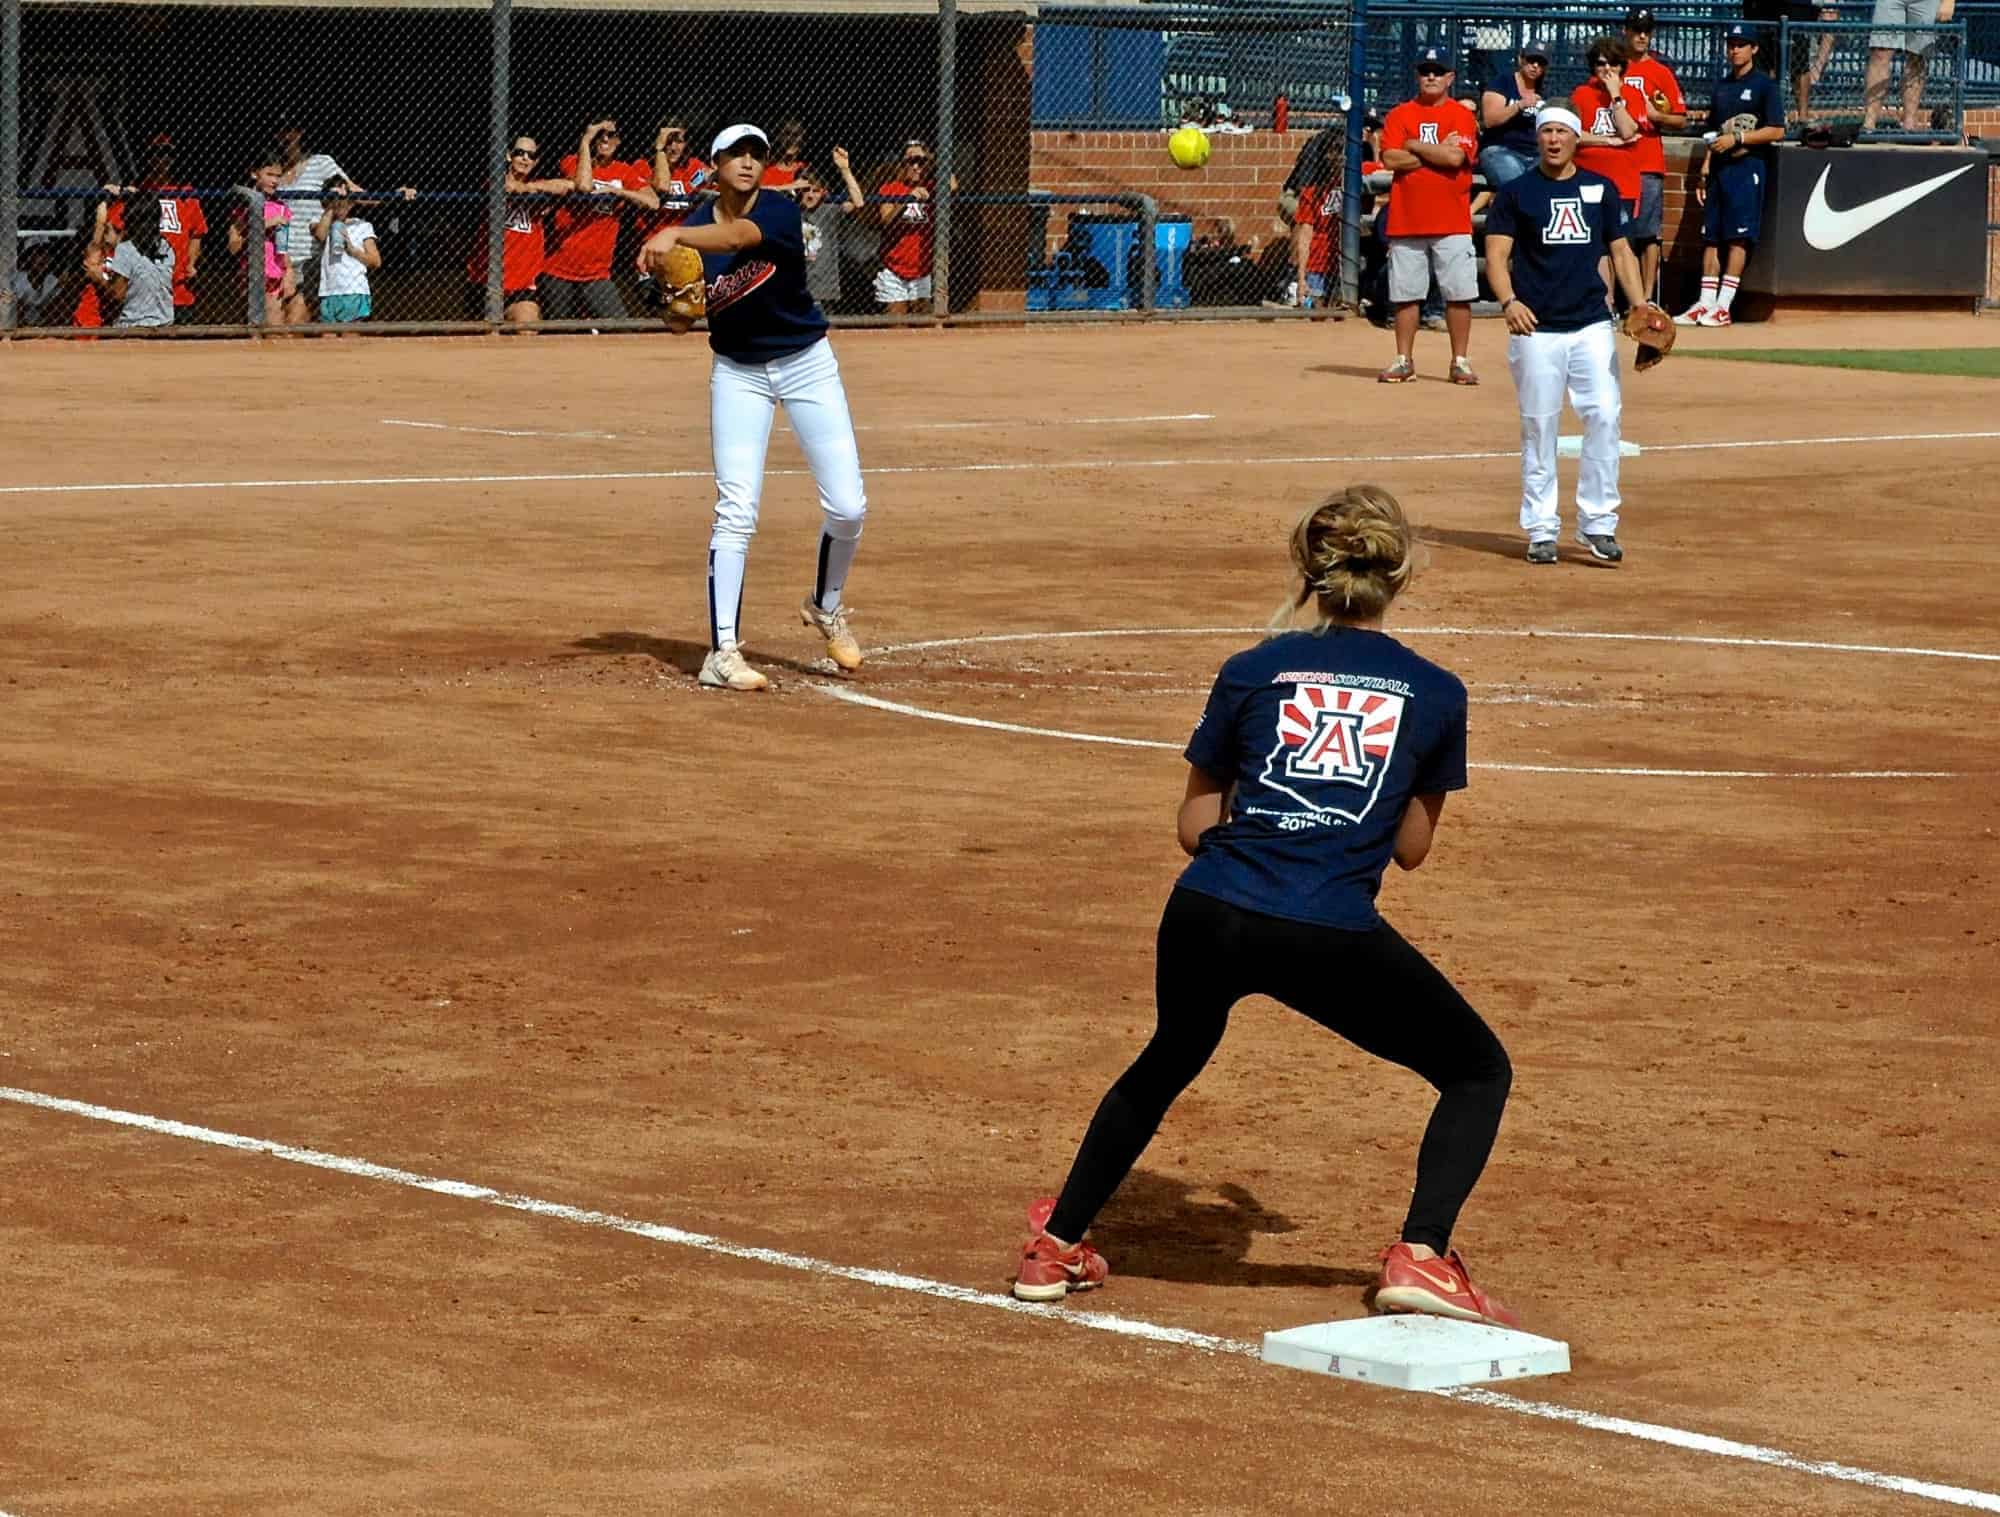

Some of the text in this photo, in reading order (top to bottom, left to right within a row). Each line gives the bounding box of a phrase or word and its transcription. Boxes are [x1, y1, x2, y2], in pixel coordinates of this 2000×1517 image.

[1419, 123, 1439, 145] A
[1591, 107, 1617, 137] A
[159, 200, 182, 234] A
[504, 204, 532, 234] A
[1542, 198, 1592, 245] A
[1286, 710, 1375, 788] A
[1327, 1355, 1341, 1374] A
[1489, 1359, 1503, 1378] A
